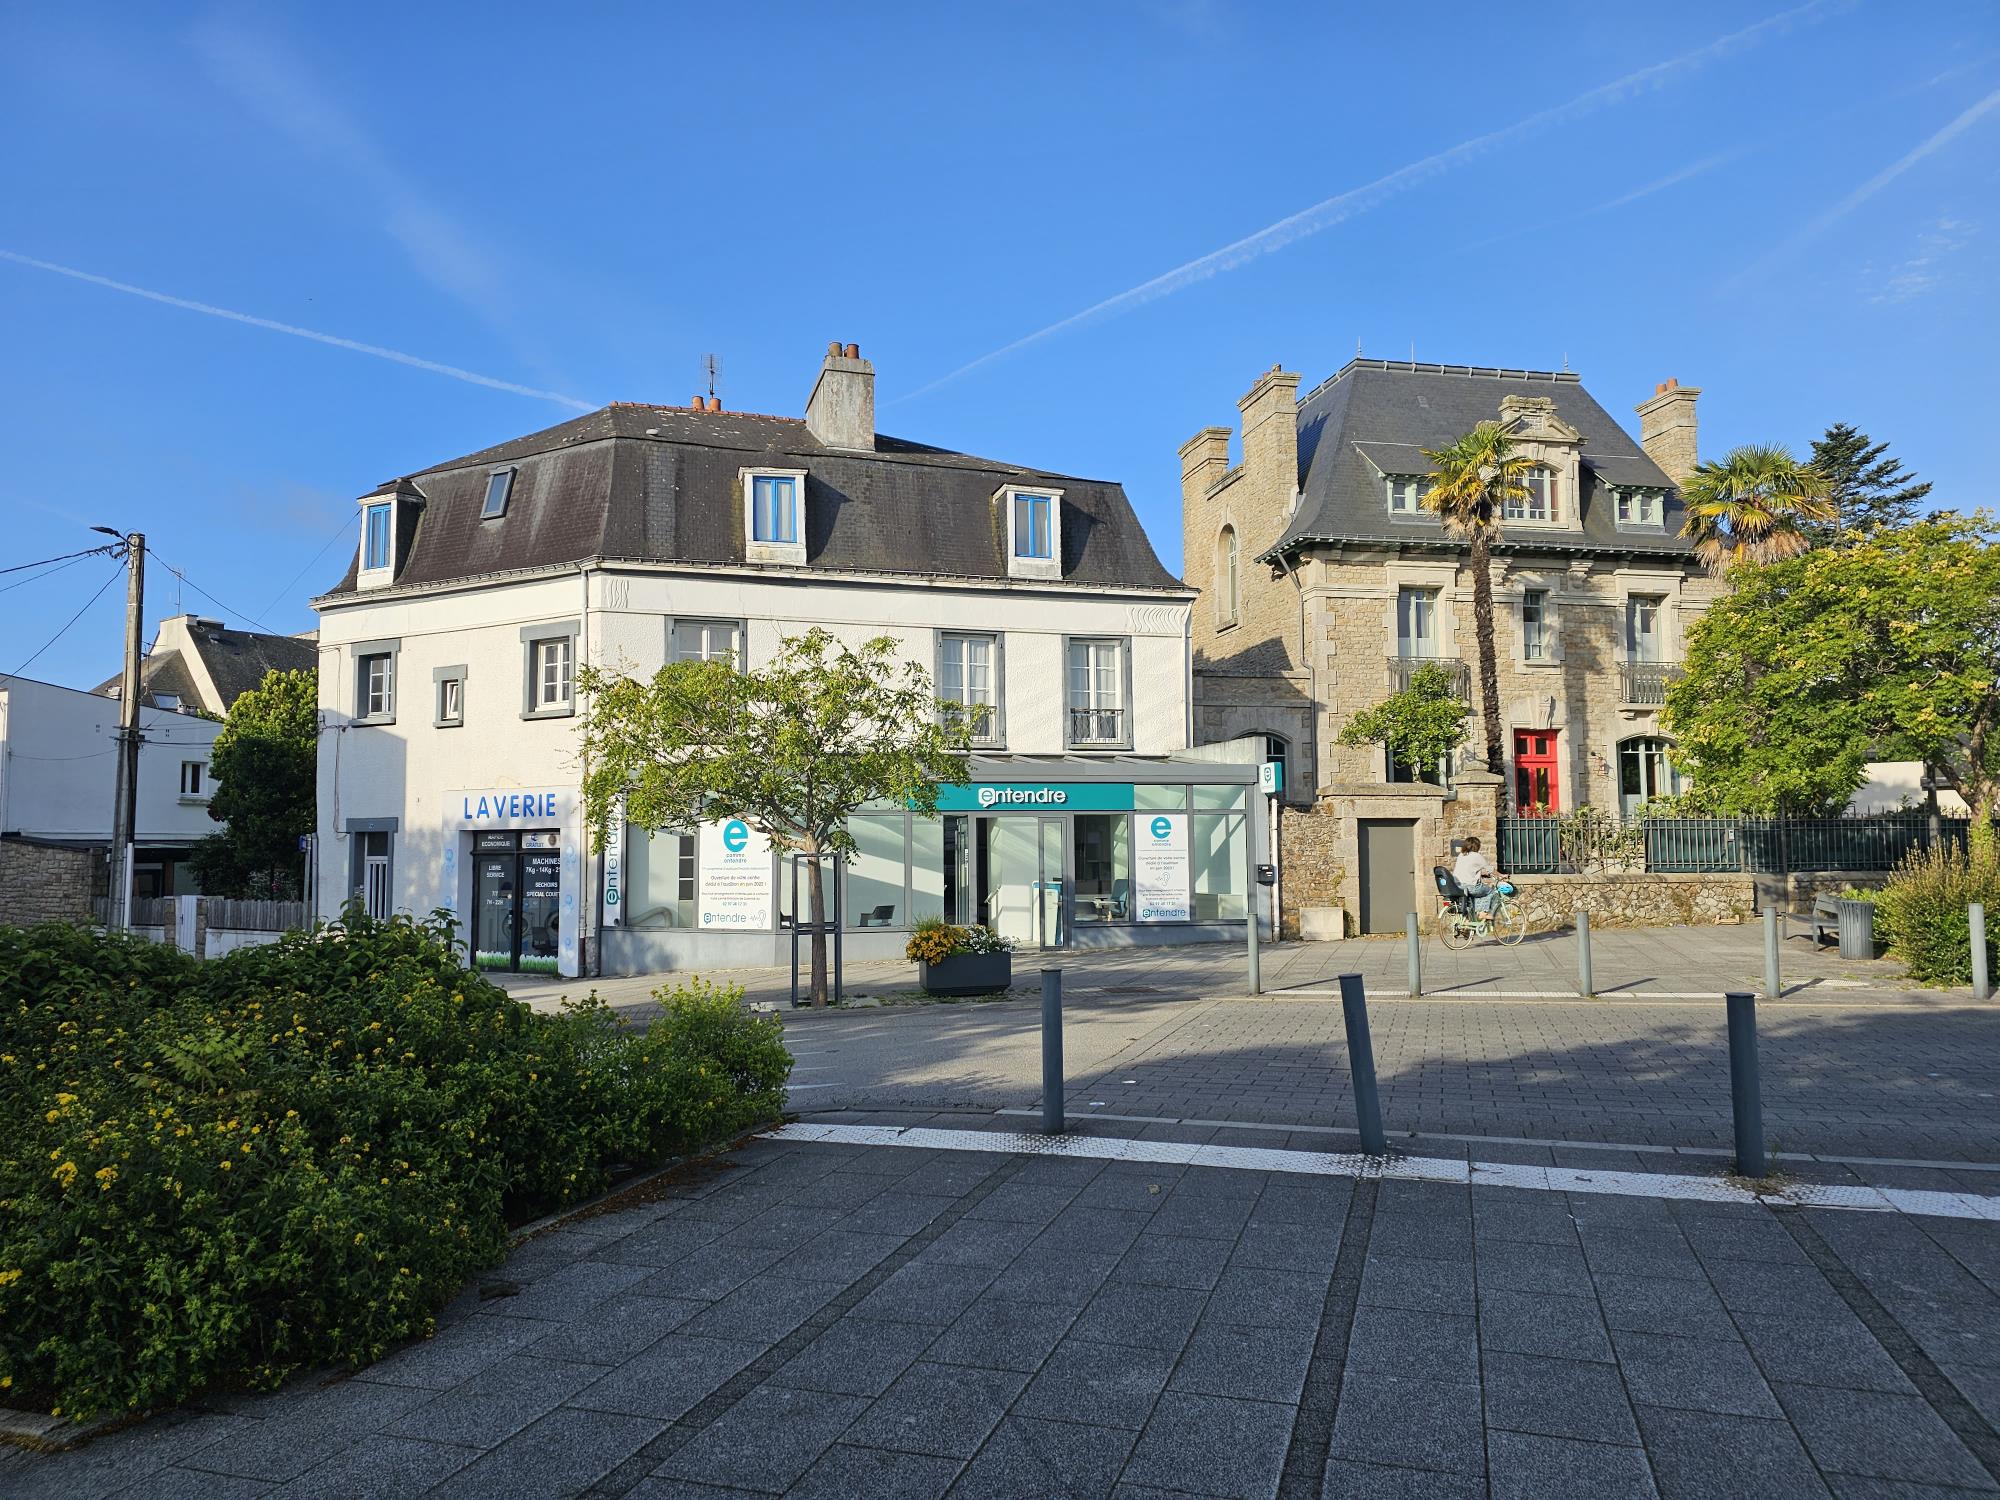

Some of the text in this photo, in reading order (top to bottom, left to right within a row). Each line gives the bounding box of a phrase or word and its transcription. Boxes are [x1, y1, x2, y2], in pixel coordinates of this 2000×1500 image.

[978, 787, 1067, 807] entendre
[464, 793, 556, 820] LAVERIE
[1150, 816, 1172, 839] e
[723, 819, 749, 853] e
[532, 857, 561, 865] MACHINES
[525, 866, 536, 875] 7Kg
[539, 866, 552, 875] 14Kg
[703, 912, 747, 925] entendre
[1143, 908, 1187, 919] entendre
